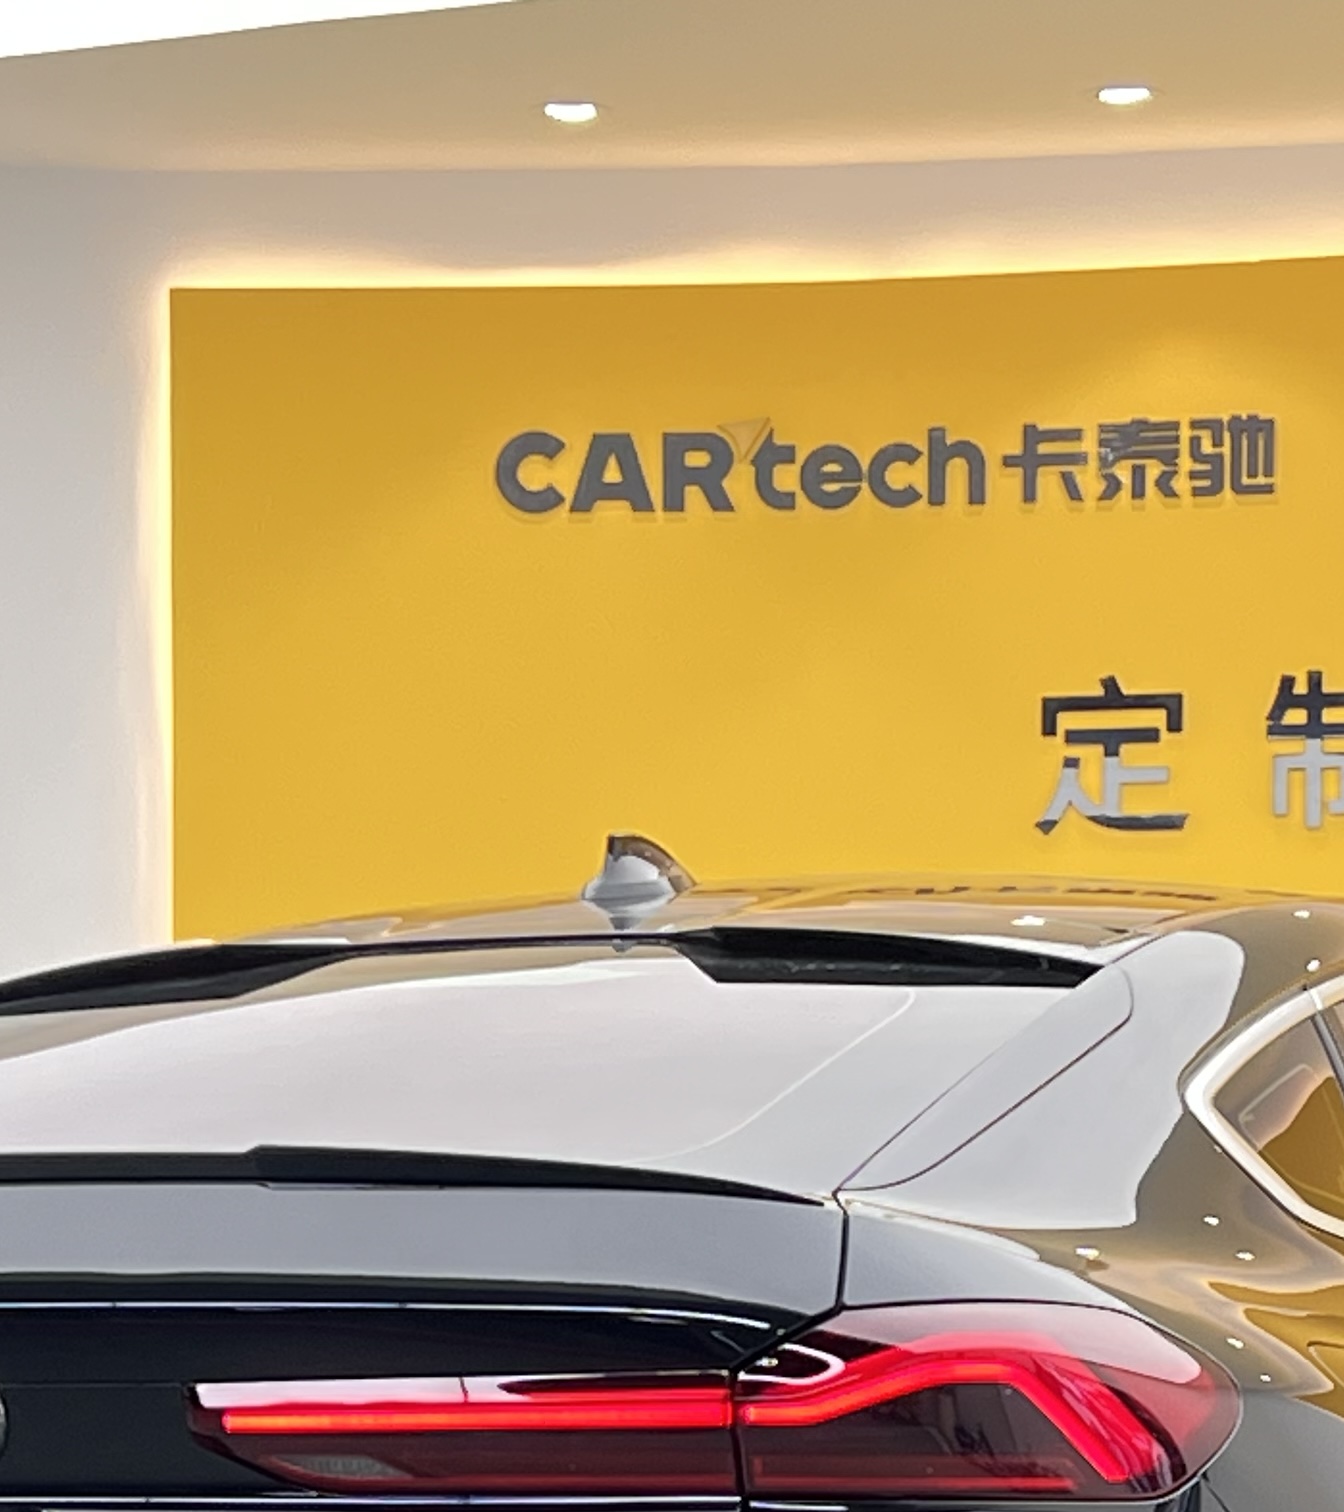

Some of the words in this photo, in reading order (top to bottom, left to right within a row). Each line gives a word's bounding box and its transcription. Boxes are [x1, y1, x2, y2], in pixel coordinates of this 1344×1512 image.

[496, 427, 987, 513] CARtech
[1002, 414, 1276, 505] 卡泰驰
